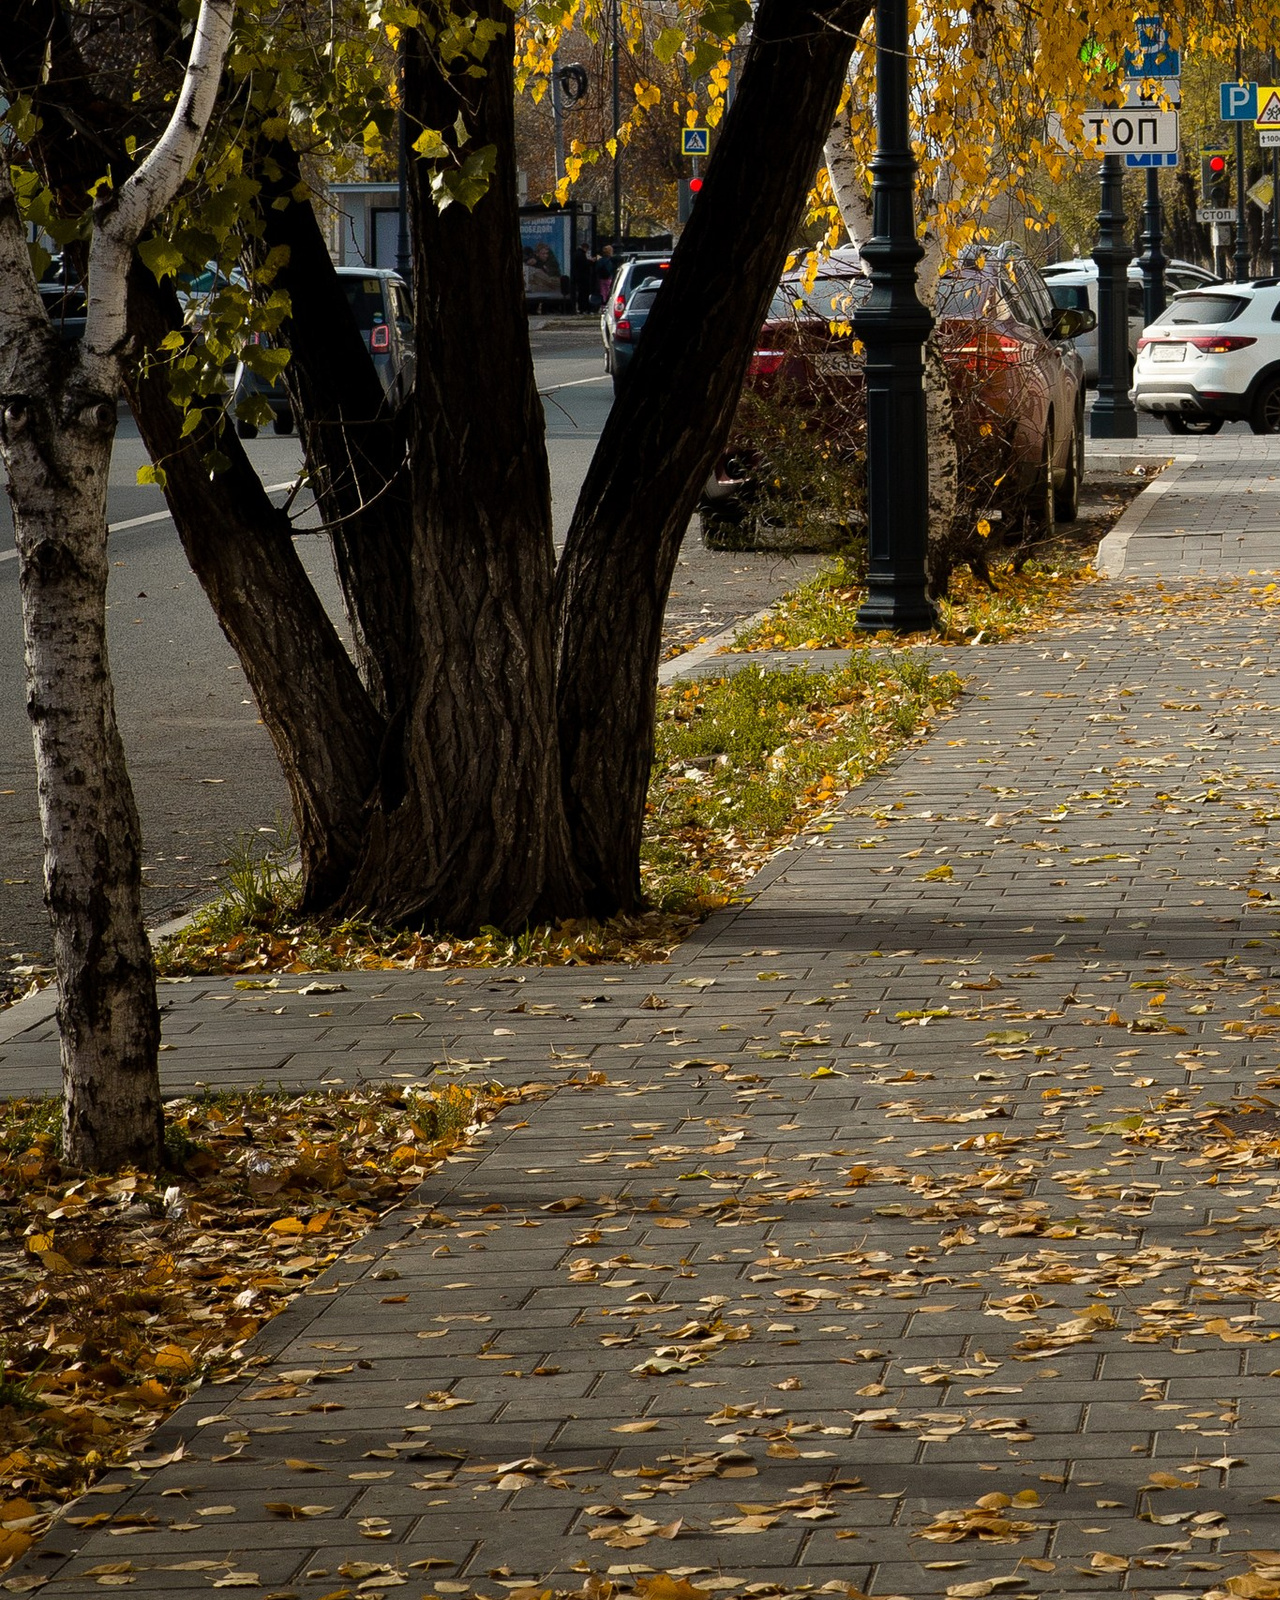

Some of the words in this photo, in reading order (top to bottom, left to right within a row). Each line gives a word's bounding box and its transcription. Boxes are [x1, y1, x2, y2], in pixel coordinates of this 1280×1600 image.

[1229, 87, 1250, 116] P
[1070, 118, 1157, 145] ТОП
[1202, 211, 1231, 220] СТОП
